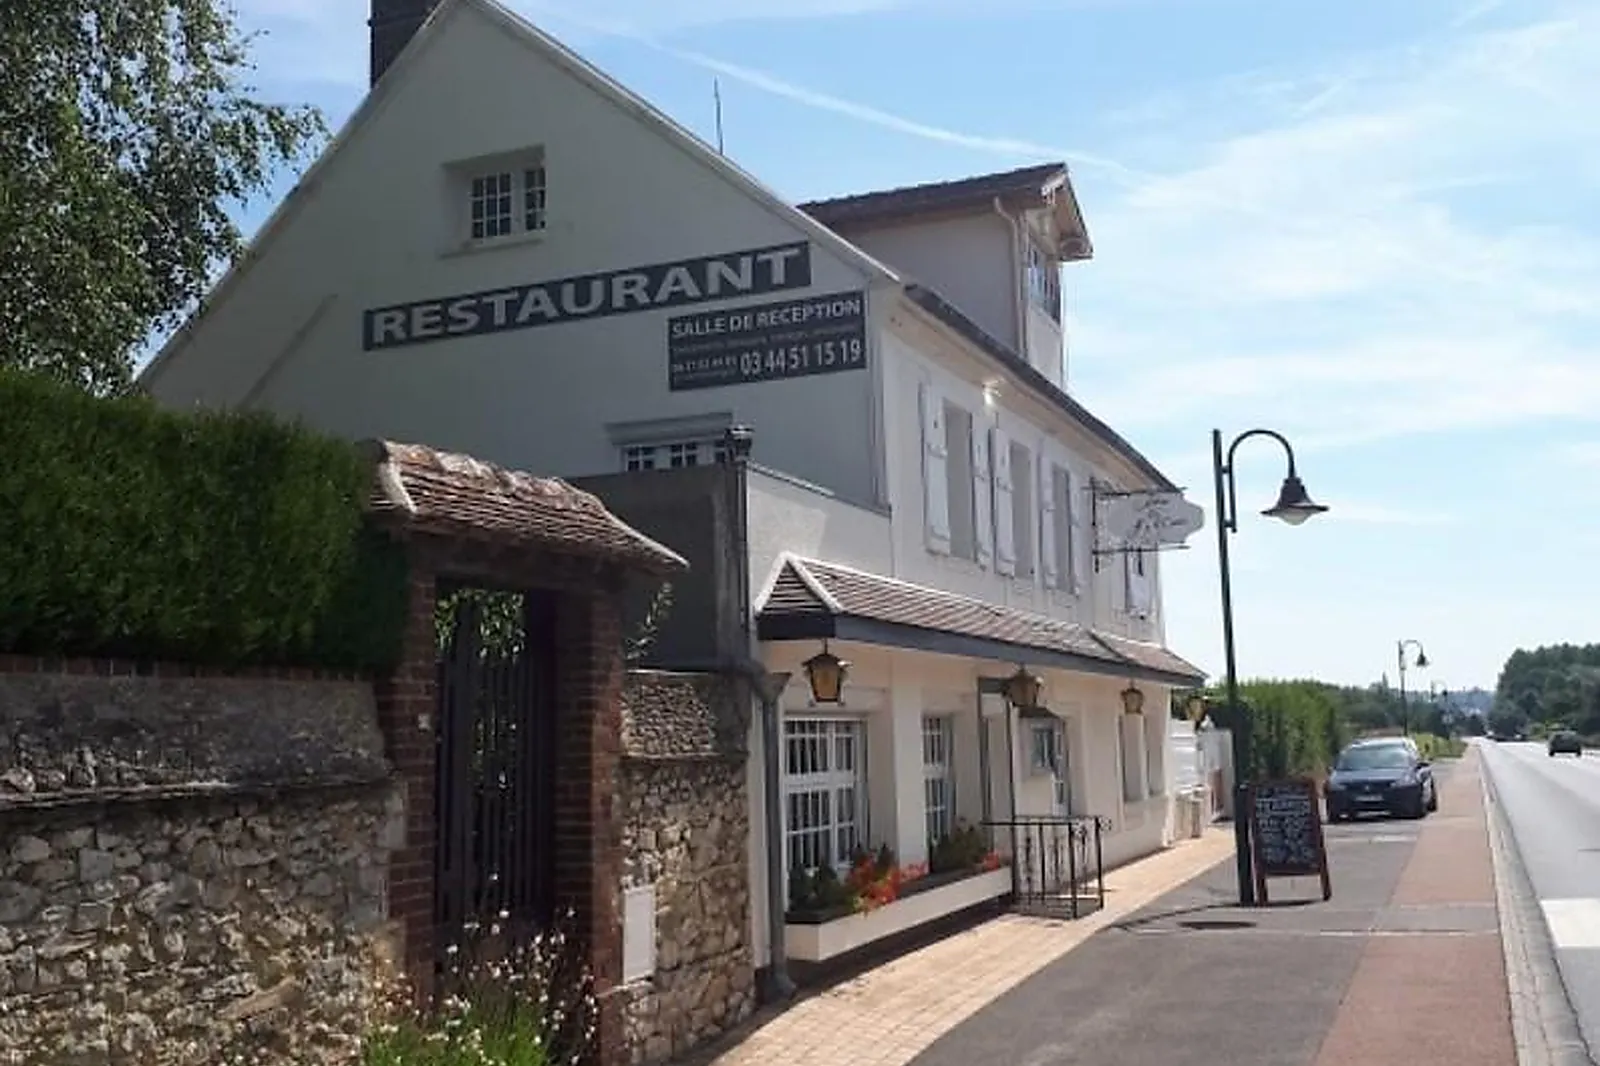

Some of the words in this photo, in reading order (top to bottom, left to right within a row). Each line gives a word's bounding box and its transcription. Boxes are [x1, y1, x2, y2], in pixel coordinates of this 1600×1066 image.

[372, 248, 800, 343] RESTAURANT
[672, 317, 726, 339] SALLE
[741, 351, 761, 375] 03
[765, 347, 786, 373] 44
[789, 345, 808, 369] 51
[814, 341, 835, 365] 15
